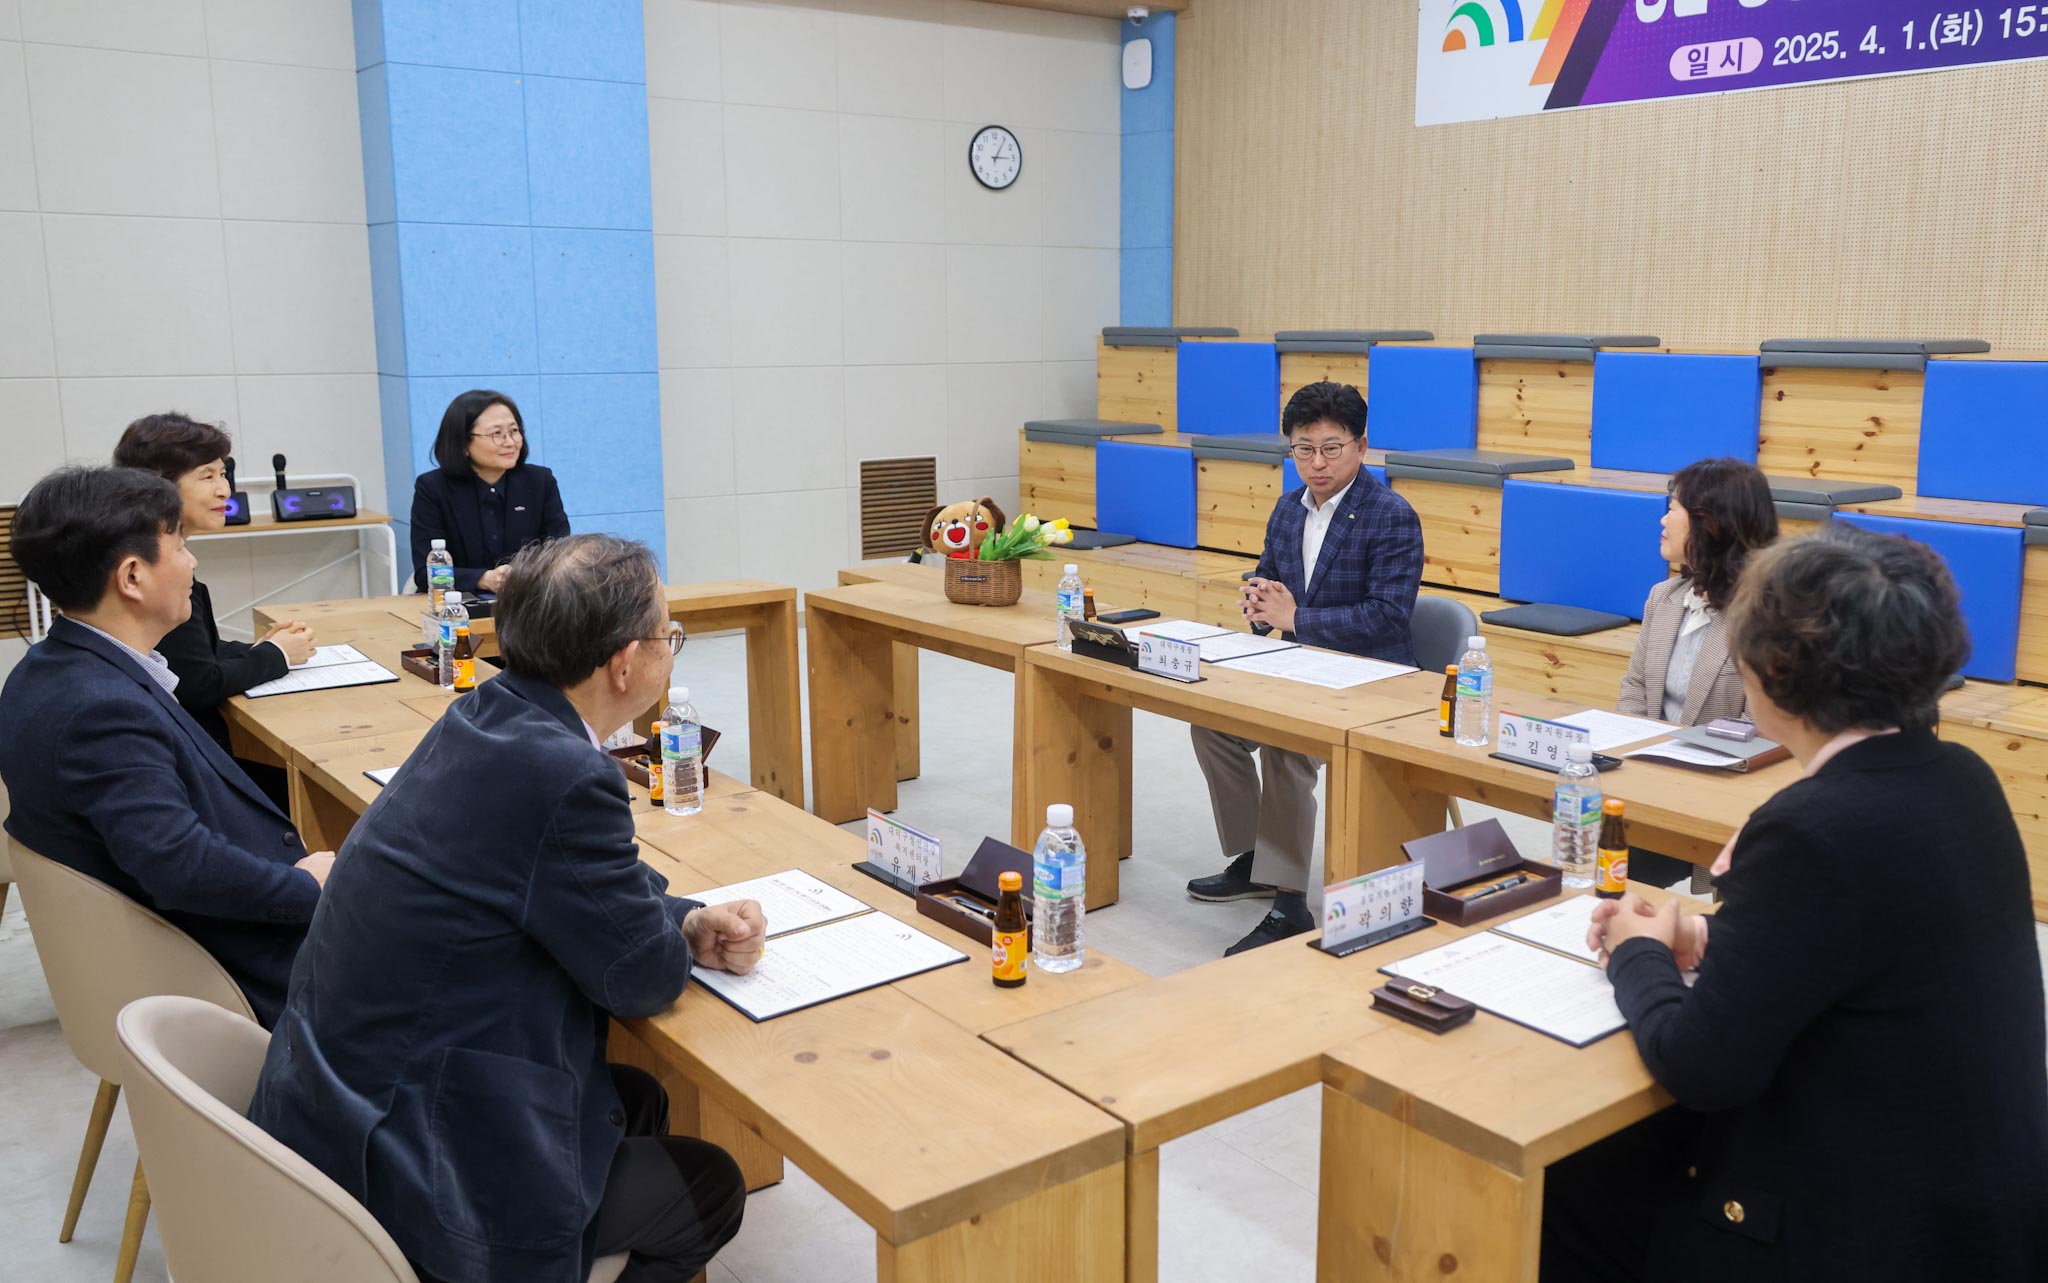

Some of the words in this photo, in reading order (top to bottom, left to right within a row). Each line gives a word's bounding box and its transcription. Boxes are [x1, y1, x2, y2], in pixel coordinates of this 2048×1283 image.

[1772, 30, 1847, 66] 2025.
[1859, 25, 1886, 54] 4.
[1902, 8, 1984, 51] 1.(화)
